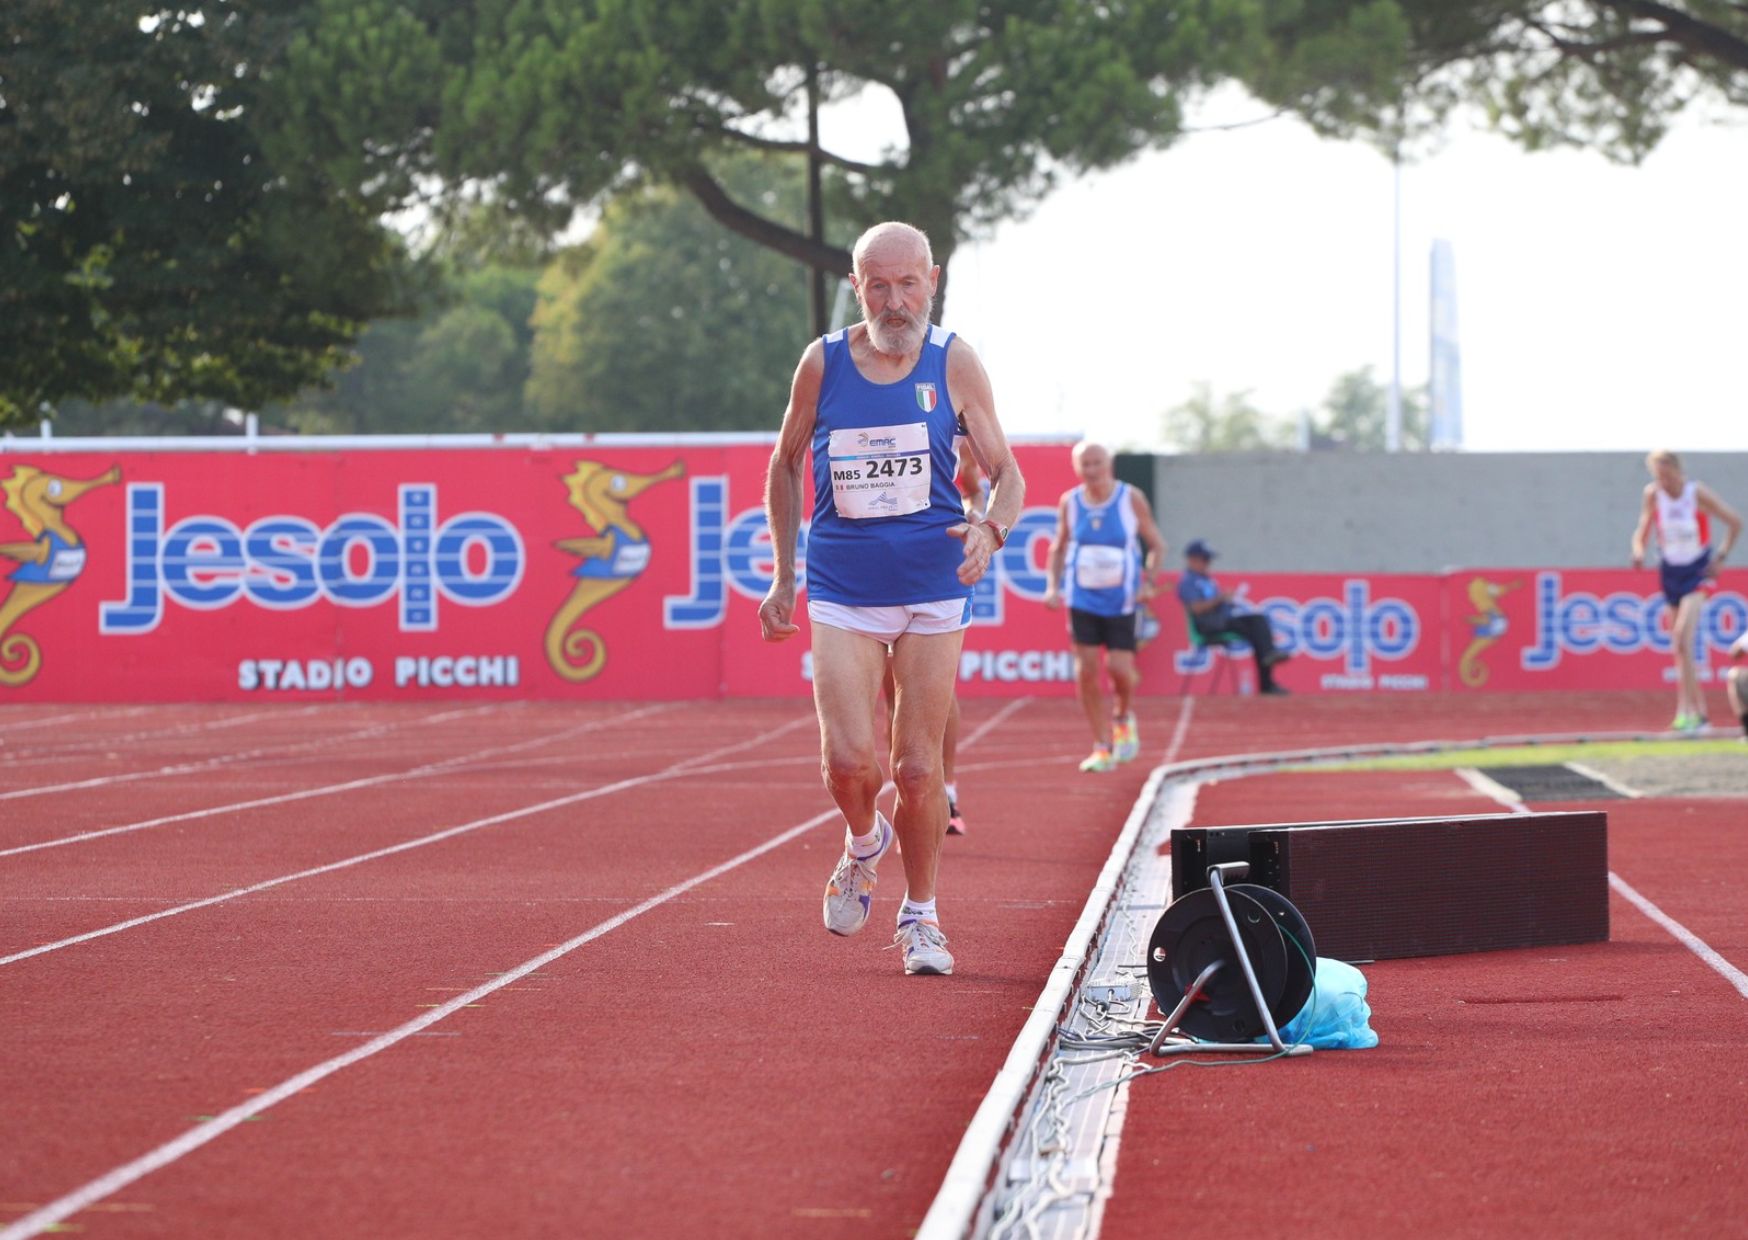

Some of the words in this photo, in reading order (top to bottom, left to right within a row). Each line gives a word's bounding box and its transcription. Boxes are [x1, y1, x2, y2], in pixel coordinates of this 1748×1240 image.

[833, 469, 861, 481] M85
[866, 457, 923, 479] 2473
[870, 481, 896, 489] BAGGIA
[99, 482, 525, 635] Jesolo
[238, 658, 373, 691] STADIO
[394, 655, 519, 688] PICCHI
[959, 650, 1075, 682] PICCH
